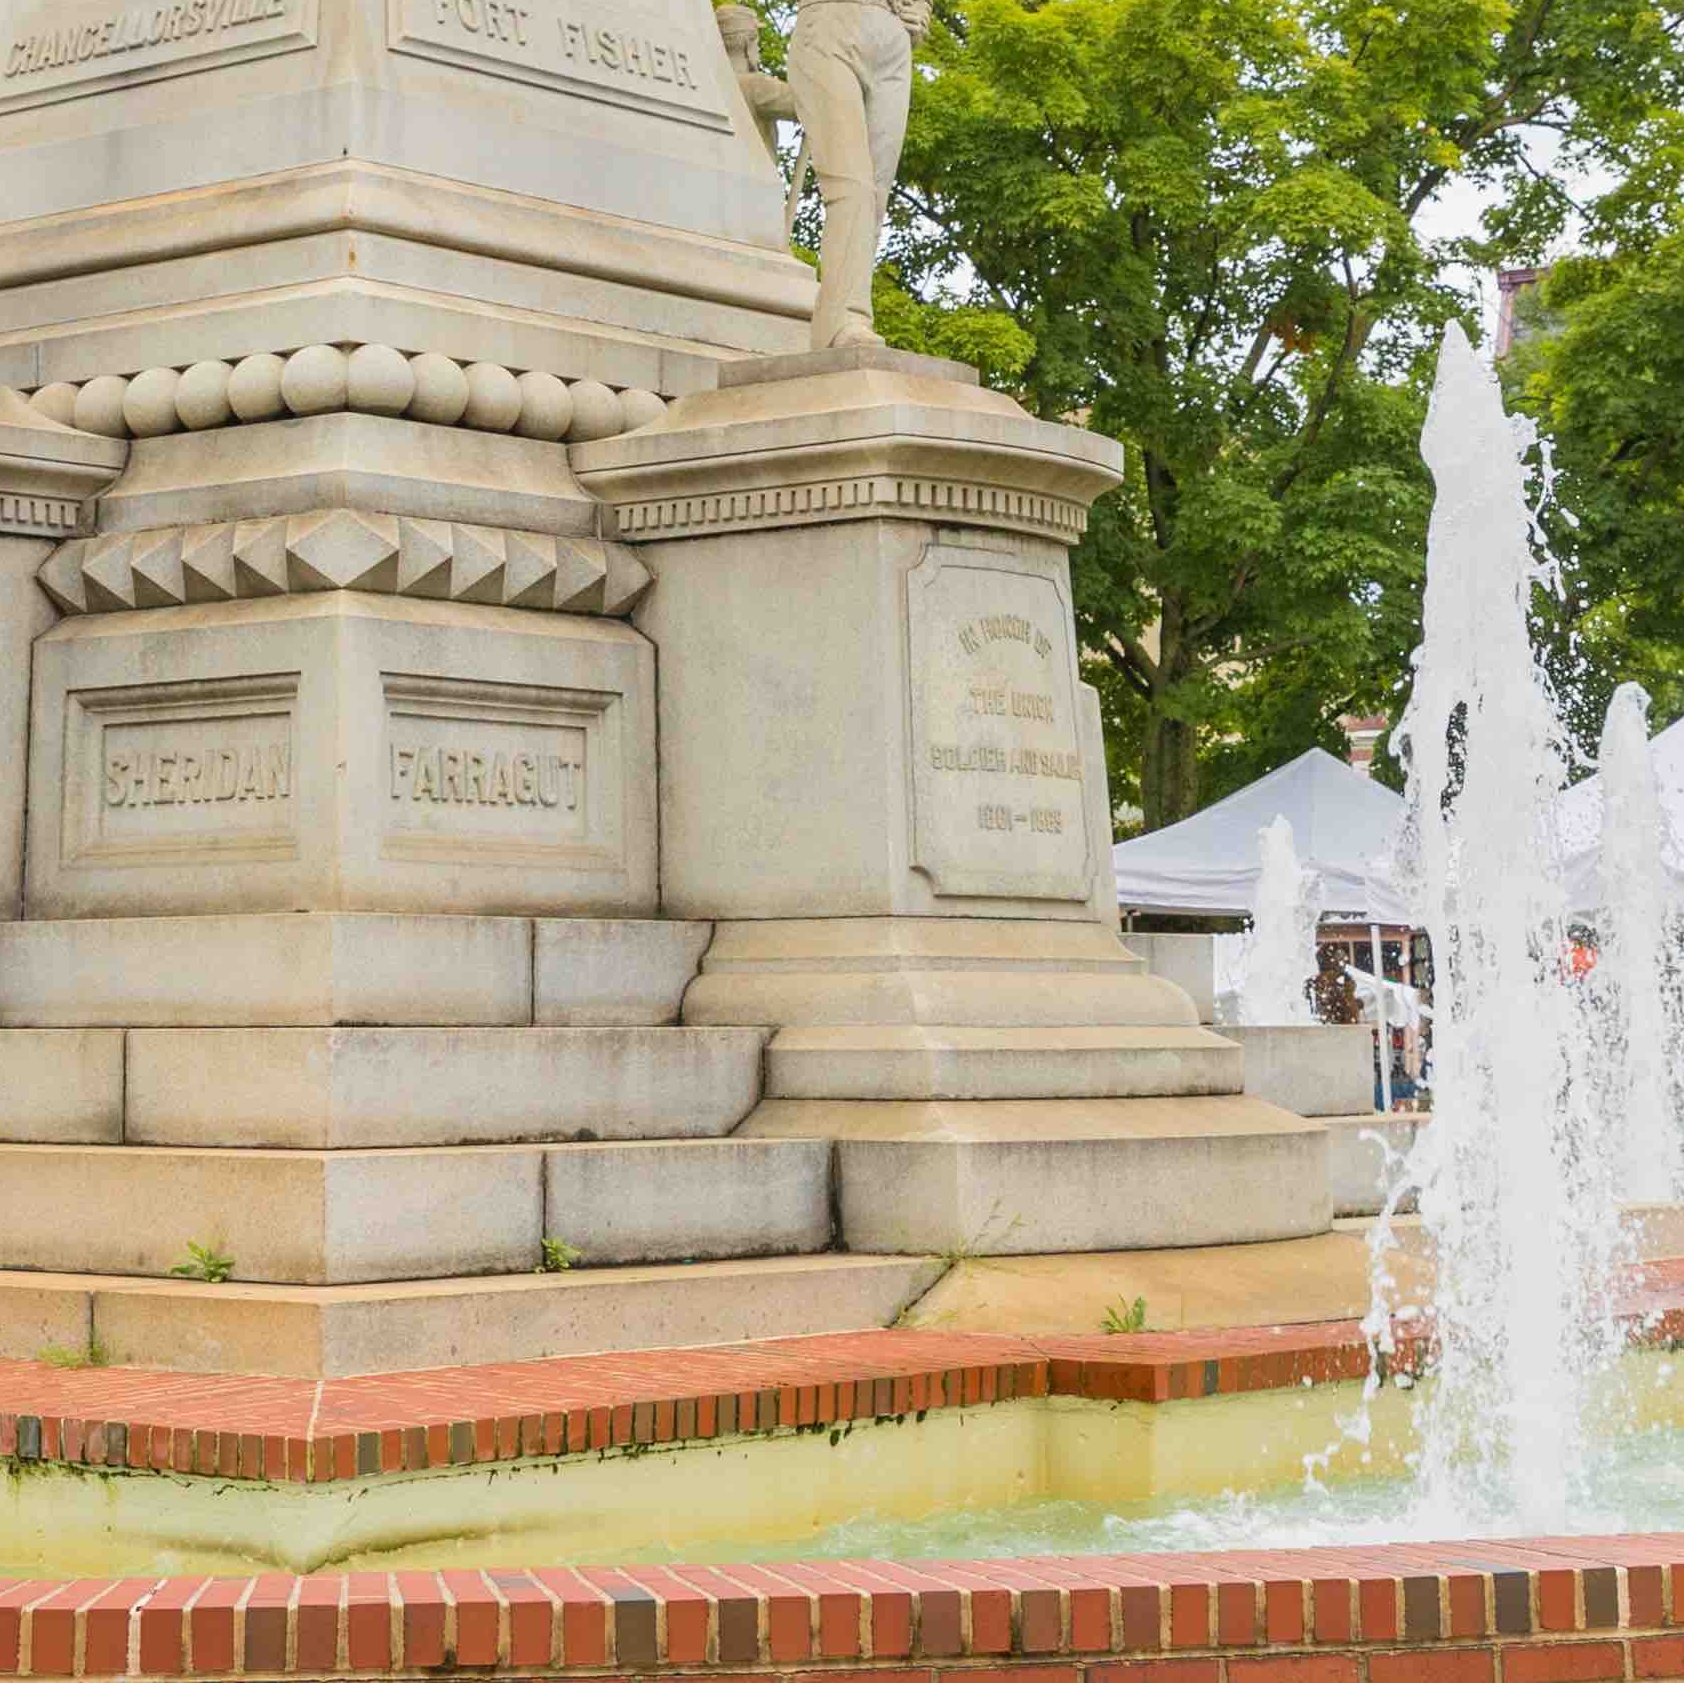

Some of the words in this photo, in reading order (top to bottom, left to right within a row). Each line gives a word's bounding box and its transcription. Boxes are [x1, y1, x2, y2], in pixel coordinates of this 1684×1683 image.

[558, 16, 698, 91] FISHER
[104, 742, 291, 807] SHERIDAN
[389, 742, 581, 810] FARRAGUT
